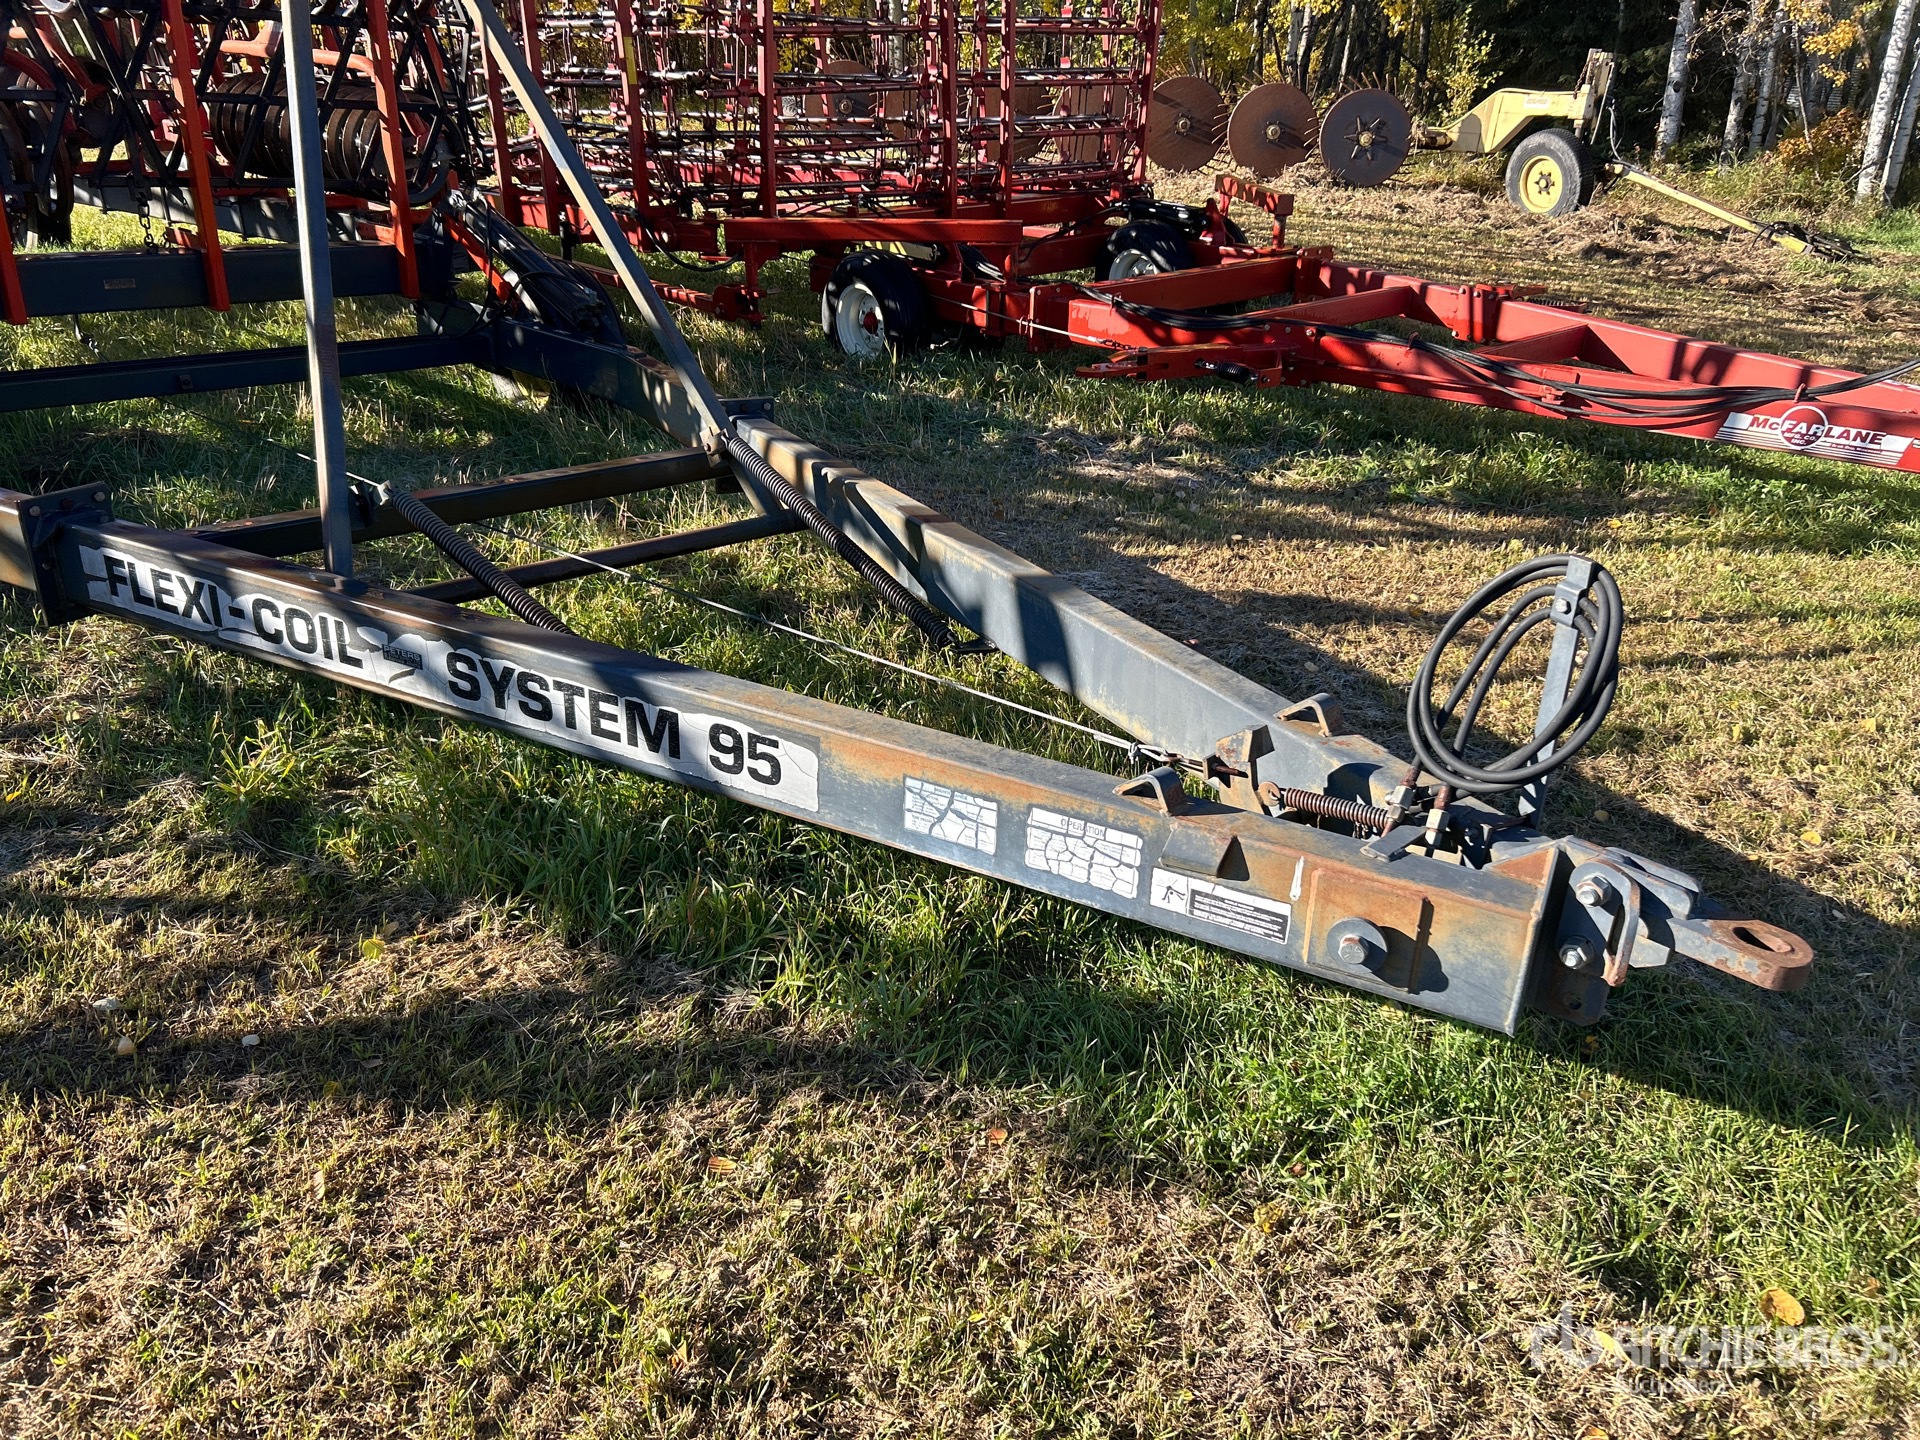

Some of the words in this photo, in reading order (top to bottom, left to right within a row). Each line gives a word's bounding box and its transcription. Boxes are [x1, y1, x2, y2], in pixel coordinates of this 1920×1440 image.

[1749, 415, 1887, 446] McFARLANE
[383, 644, 422, 661] PETERS
[102, 553, 364, 670] FLEXI-COIL
[446, 651, 682, 760] SYSTEM
[708, 722, 782, 786] 95
